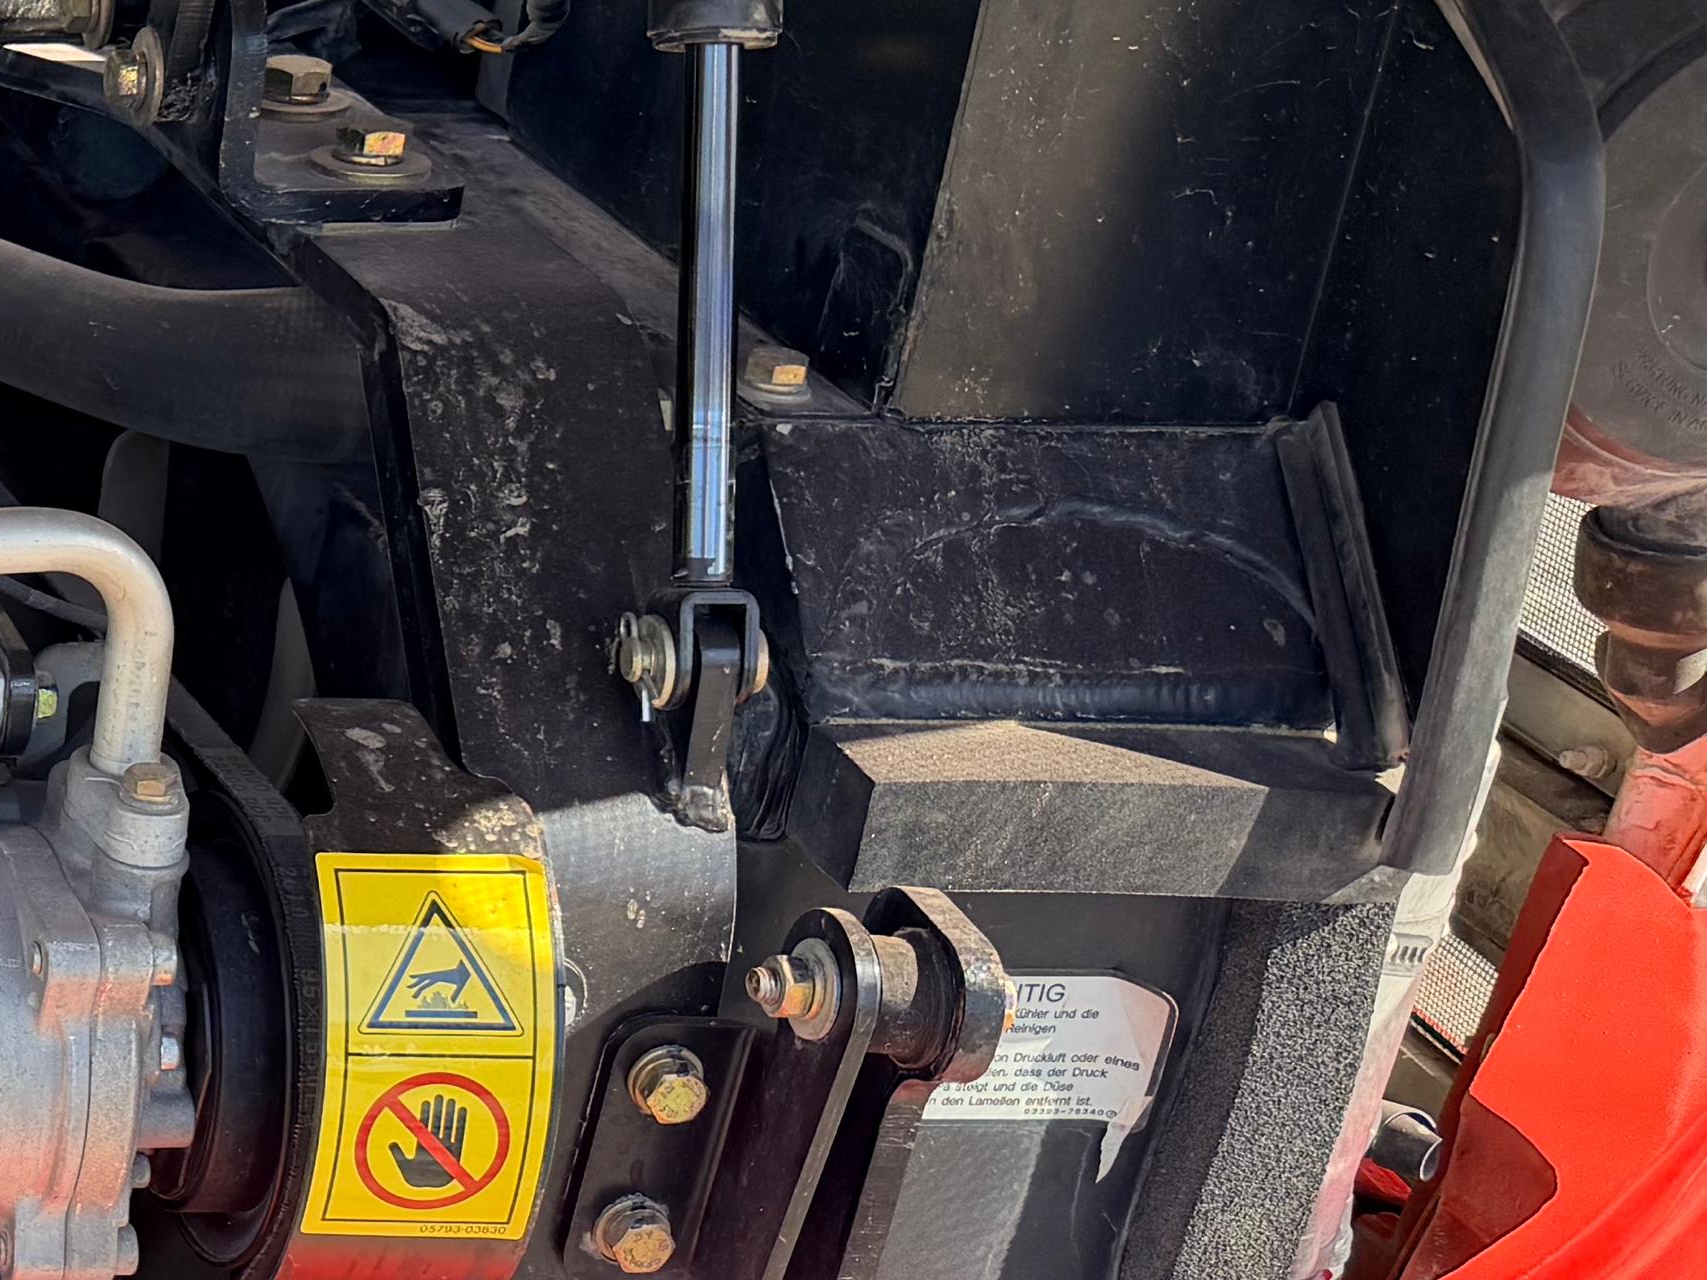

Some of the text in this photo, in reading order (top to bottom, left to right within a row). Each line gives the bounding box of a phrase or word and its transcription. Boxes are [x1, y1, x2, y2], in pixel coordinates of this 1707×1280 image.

[1017, 983, 1066, 1003] TIG
[1054, 1009, 1077, 1019] und
[1081, 1009, 1100, 1019] die
[1014, 1052, 1067, 1064] Druckluft
[1071, 1052, 1100, 1064] oder
[1105, 1056, 1141, 1072] eines
[1014, 1067, 1043, 1078] dass
[1047, 1067, 1068, 1078] der
[1072, 1067, 1109, 1079] Druck
[993, 1082, 1017, 1092] und
[1020, 1082, 1039, 1092] die
[1043, 1081, 1075, 1092] Düse
[941, 1096, 964, 1106] den
[968, 1095, 1021, 1107] Lamellen
[1025, 1096, 1072, 1107] entfernt
